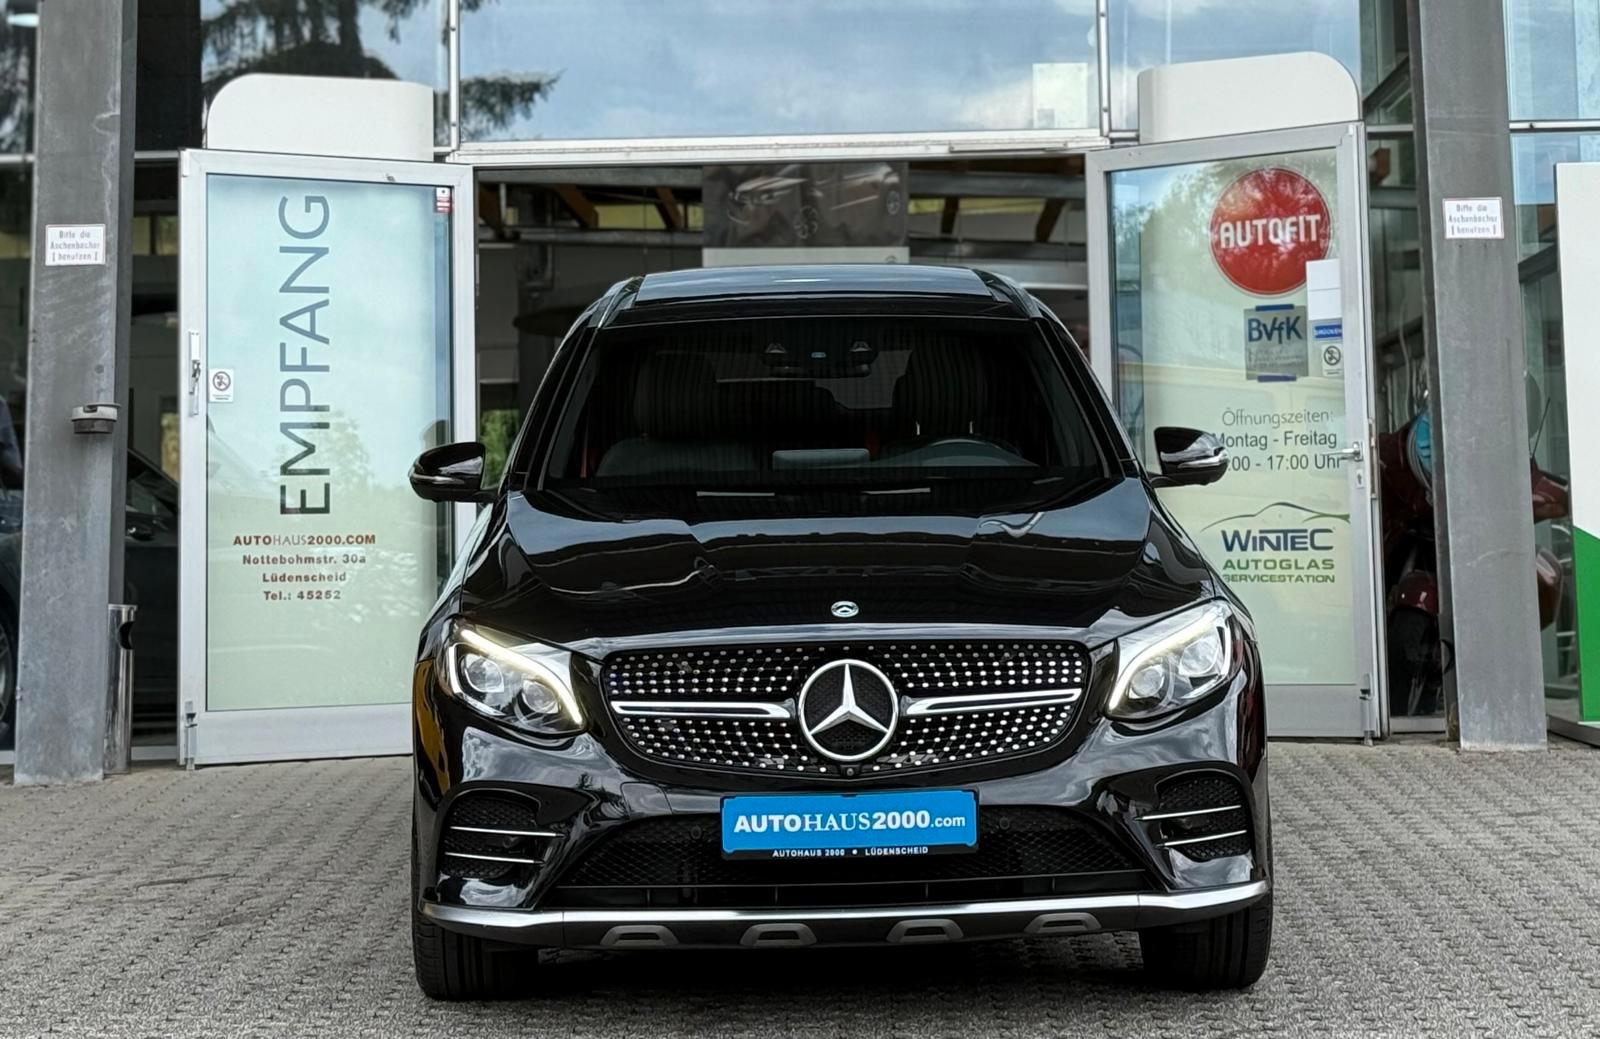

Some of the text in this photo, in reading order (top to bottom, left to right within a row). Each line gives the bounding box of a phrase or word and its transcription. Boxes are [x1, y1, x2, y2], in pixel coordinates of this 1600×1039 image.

[1220, 214, 1321, 249] AUTOFIT
[278, 195, 330, 514] EMPFANG
[1222, 407, 1334, 429] Öffnungszeiten:
[1283, 430, 1337, 449] Freitag
[1267, 454, 1309, 471] 17:00
[1314, 453, 1342, 470] Uhr
[233, 534, 376, 546] AUTOHAUS2000.COM
[242, 553, 367, 565] Nottebohmstr. 30a
[1222, 559, 1335, 570] AUTOGLAS
[262, 571, 347, 583] Lüdenscheid
[1223, 574, 1335, 584] SERVICESTATION
[264, 589, 342, 601] Tel.: 45252
[733, 809, 966, 834] AUTOHAUS2000.com
[772, 845, 929, 858] AUTOHAUS 2000 LÜDENSCHEID
